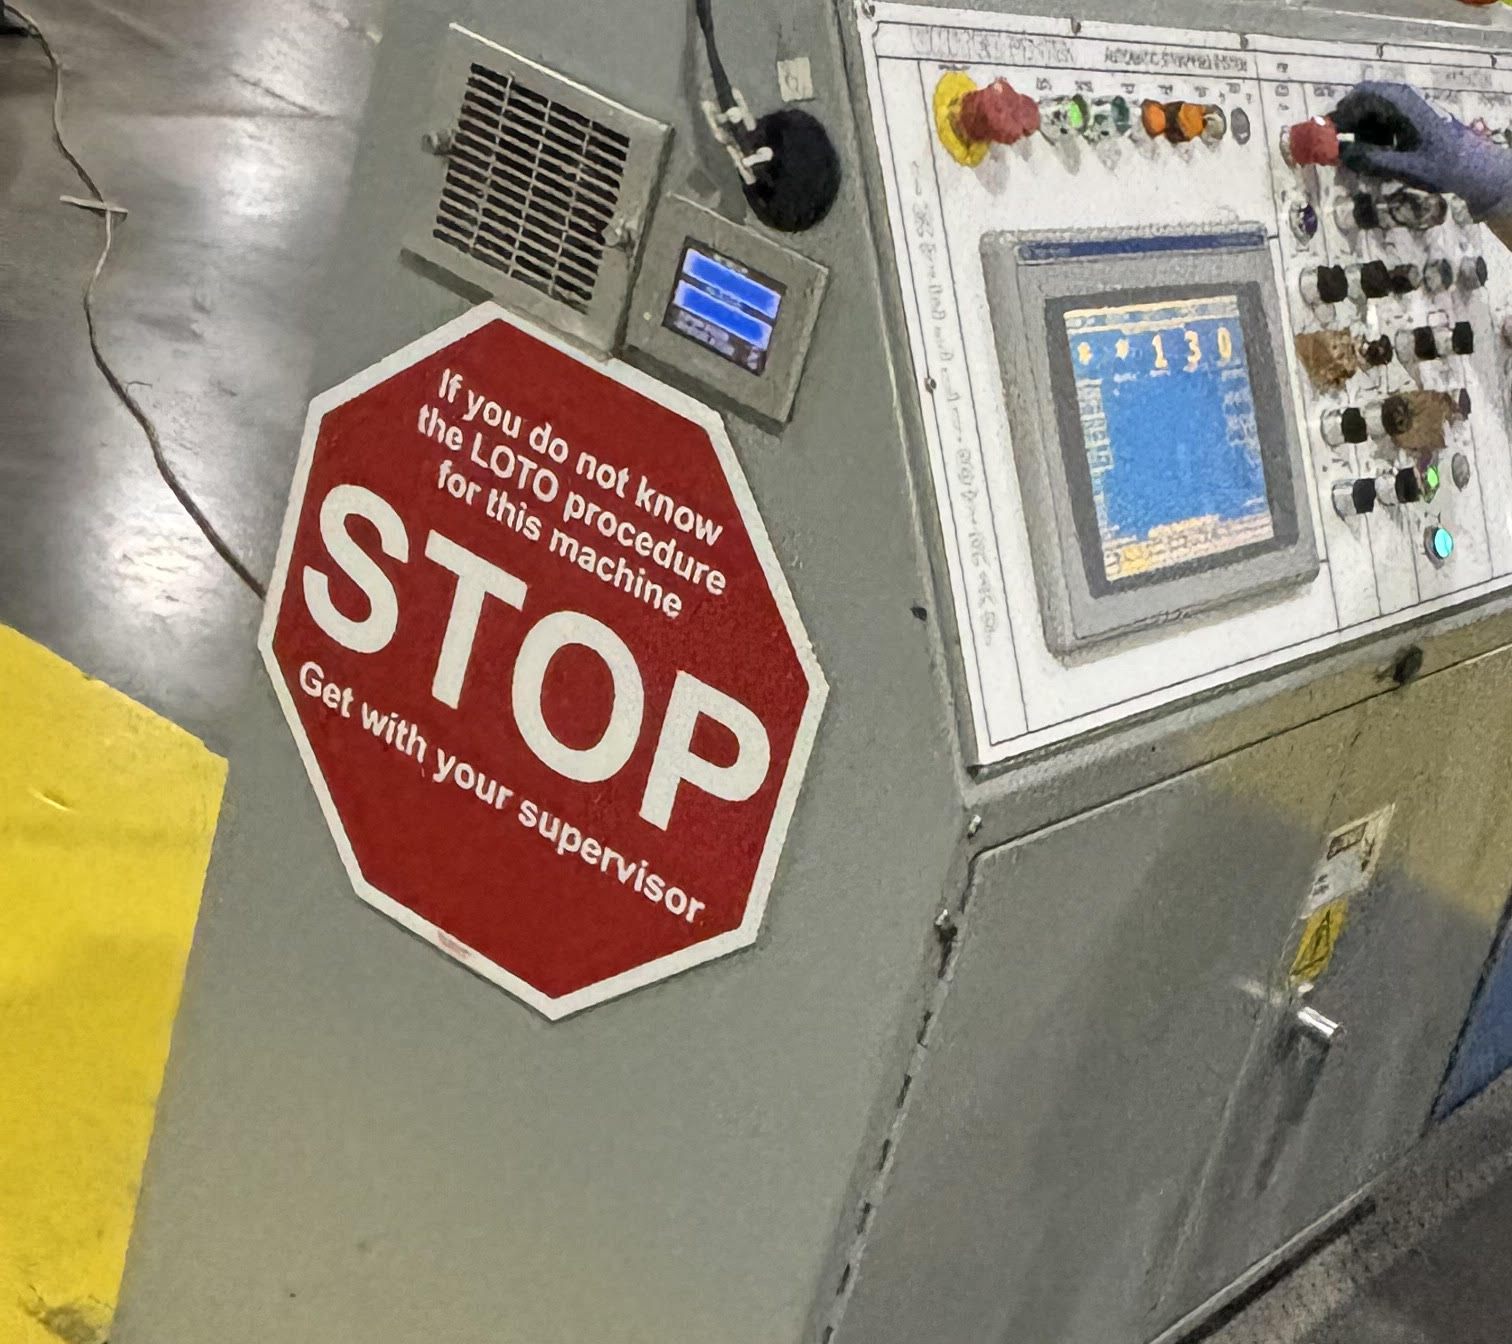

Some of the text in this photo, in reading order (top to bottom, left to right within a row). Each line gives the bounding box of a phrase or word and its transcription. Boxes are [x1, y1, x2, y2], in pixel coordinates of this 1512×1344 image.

[417, 403, 727, 596] the LOTO procedure
[437, 459, 683, 619] for this machine
[438, 368, 724, 547] If you do not know
[302, 483, 771, 832] STOP
[299, 661, 706, 923] Get with your supervisor
